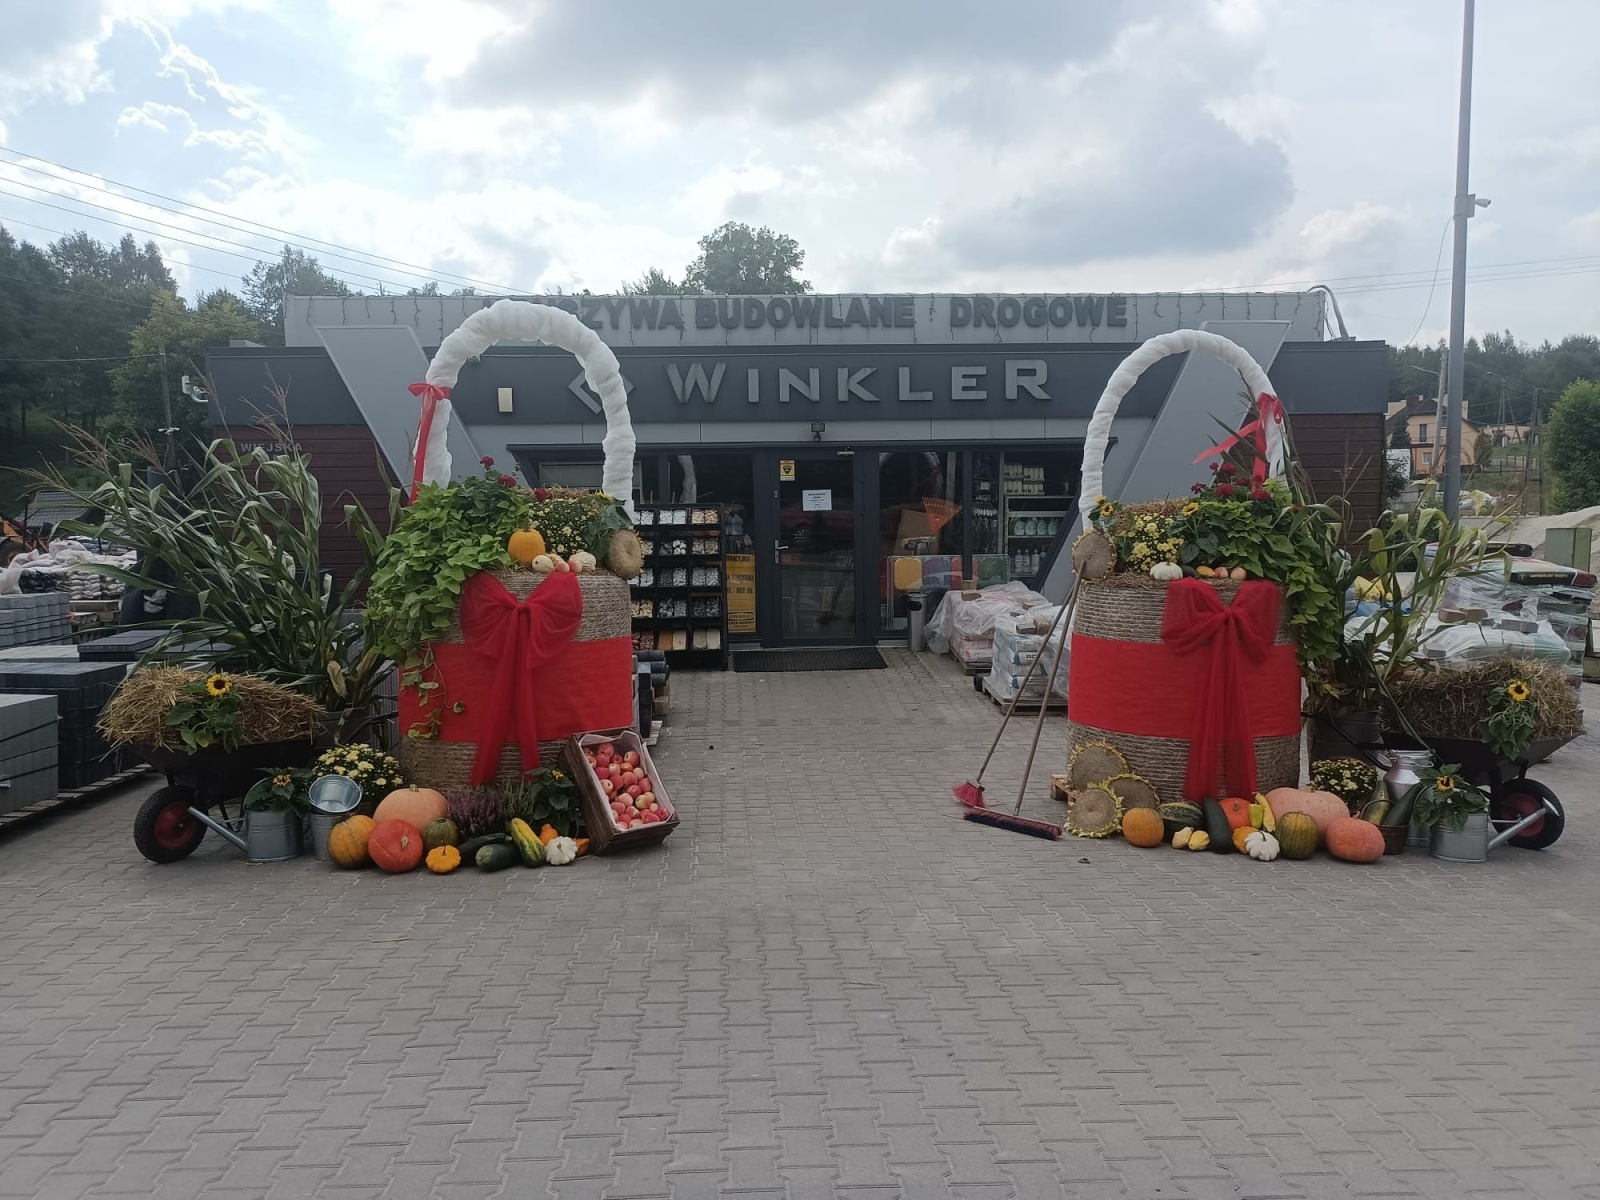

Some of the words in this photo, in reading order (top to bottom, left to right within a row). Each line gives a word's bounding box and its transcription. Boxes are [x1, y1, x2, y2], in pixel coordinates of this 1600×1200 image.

[695, 296, 915, 330] BUDOWLANE
[951, 296, 1127, 328] DROGOWE
[664, 359, 1052, 404] WINKLER
